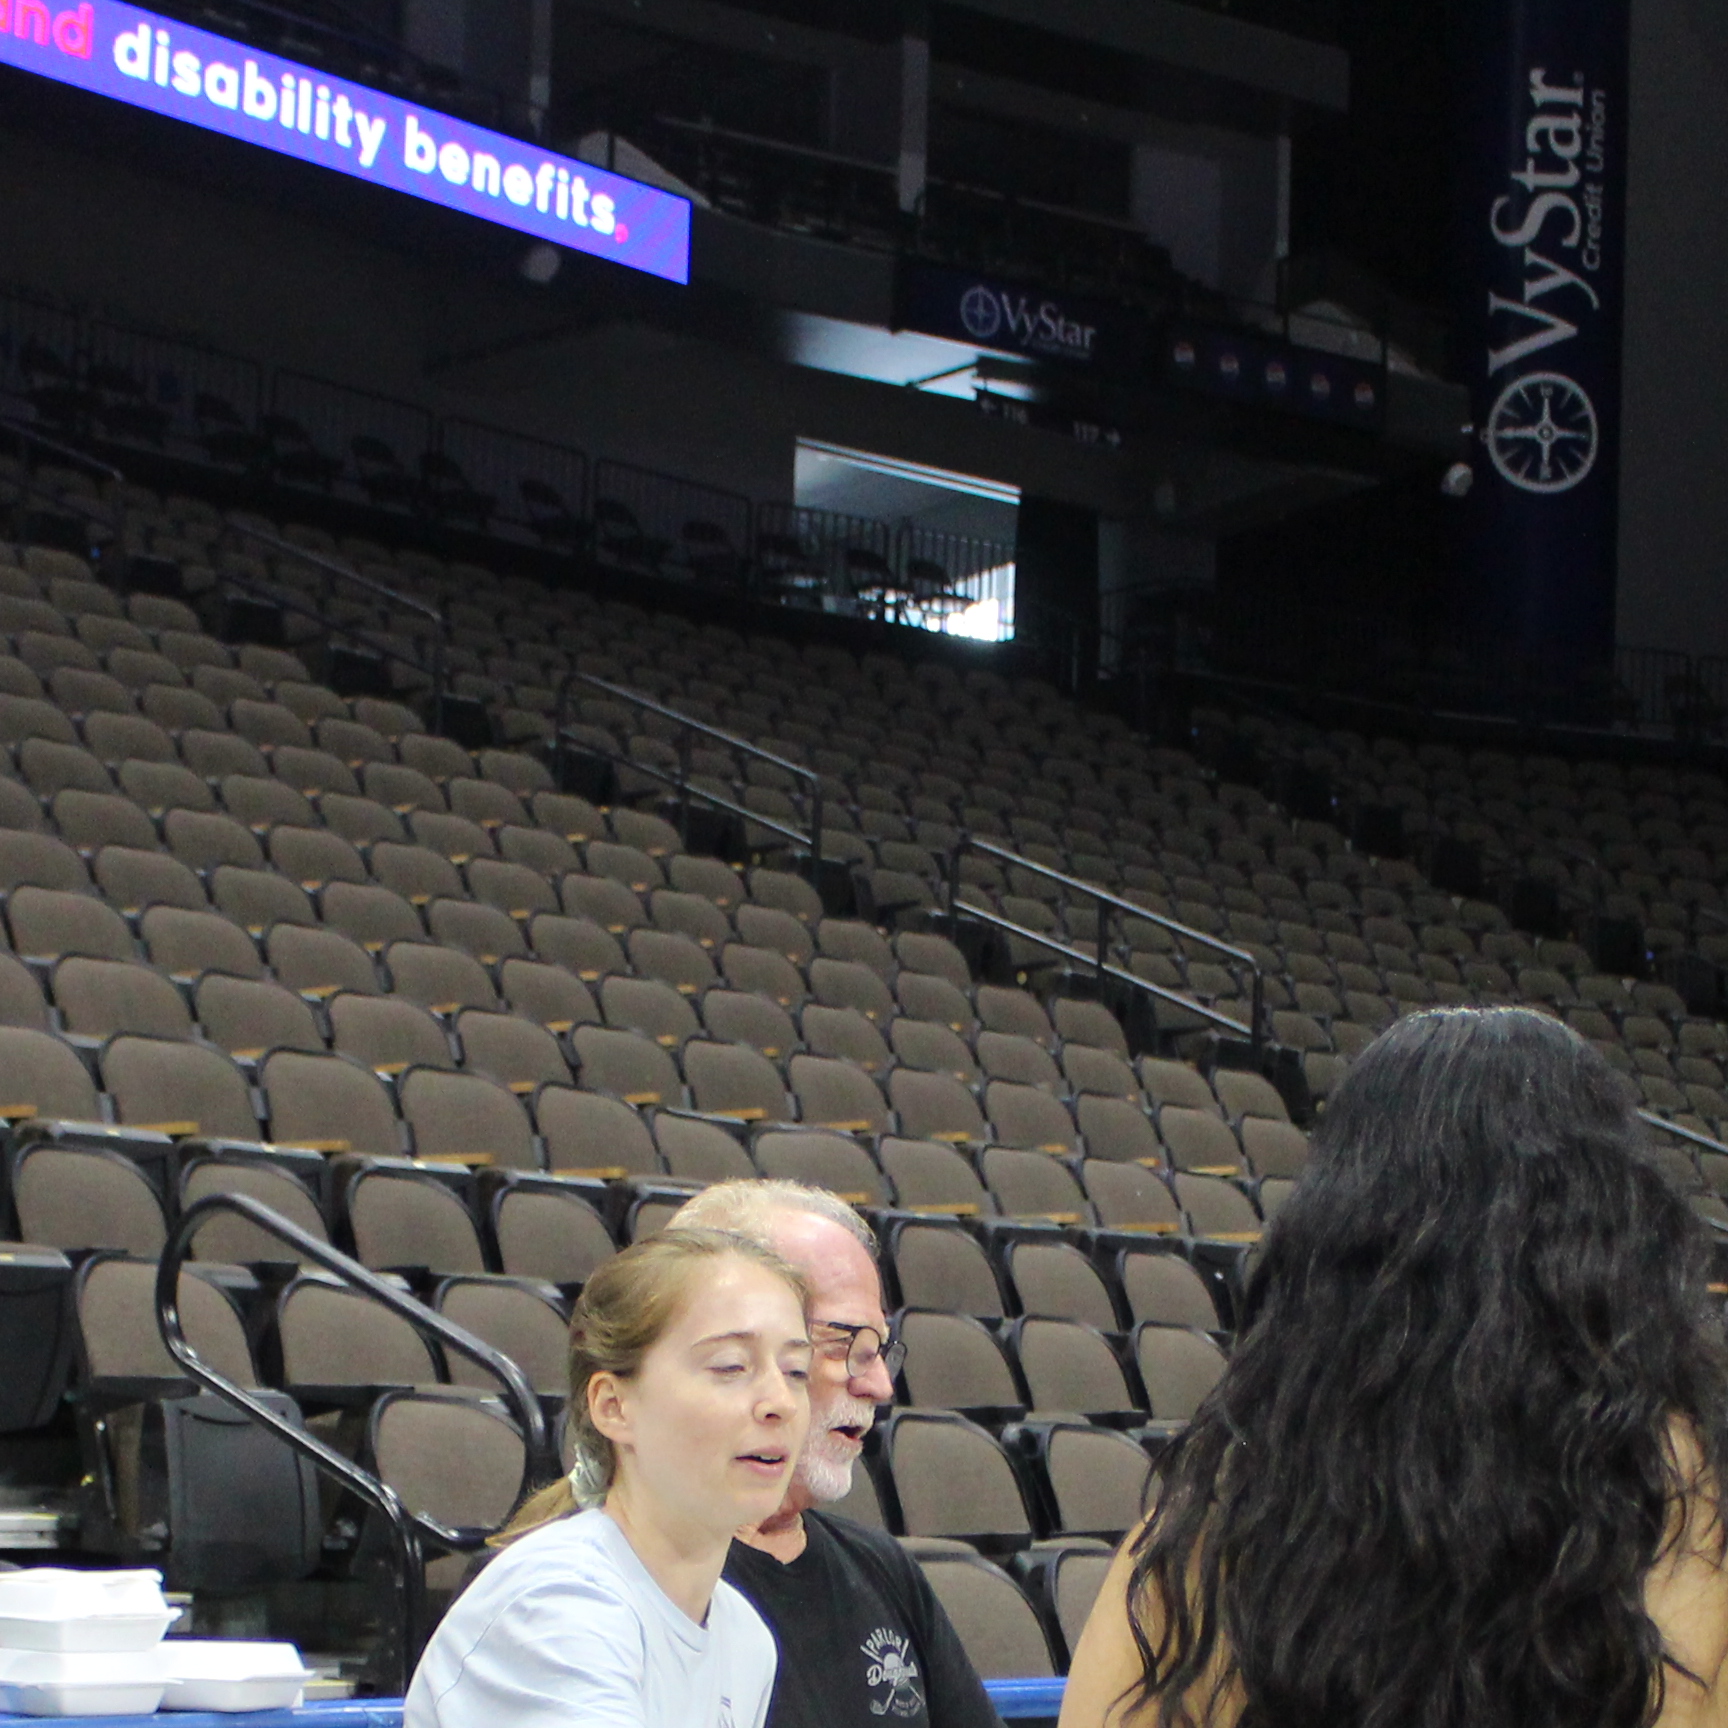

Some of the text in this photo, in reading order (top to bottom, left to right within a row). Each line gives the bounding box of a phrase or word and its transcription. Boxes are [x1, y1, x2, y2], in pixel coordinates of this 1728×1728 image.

[113, 23, 386, 168] disability
[1582, 88, 1606, 271] Credit Union
[1001, 292, 1096, 349] VyStar
